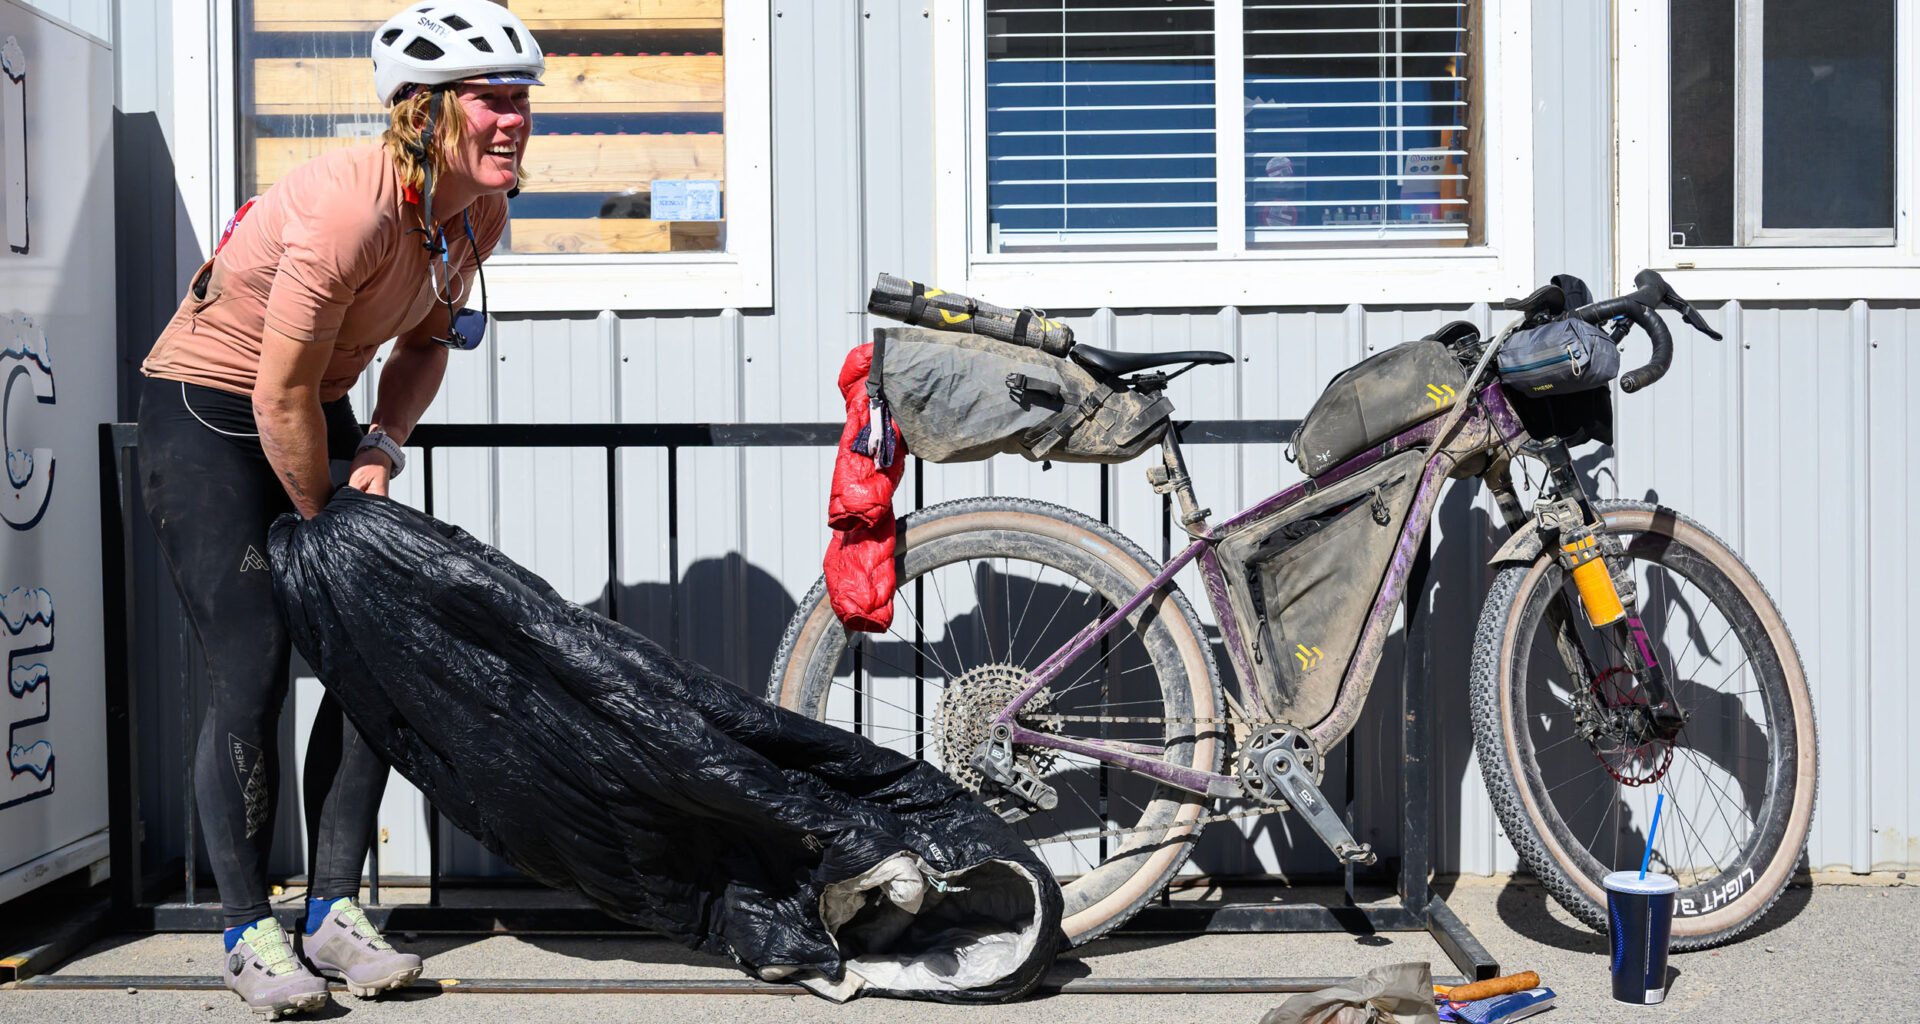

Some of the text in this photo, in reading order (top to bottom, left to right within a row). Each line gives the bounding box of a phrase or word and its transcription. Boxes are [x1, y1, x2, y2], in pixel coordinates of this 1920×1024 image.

[233, 742, 249, 775] 7MESH
[1299, 789, 1316, 807] GX
[1701, 867, 1755, 912] LIGHT
